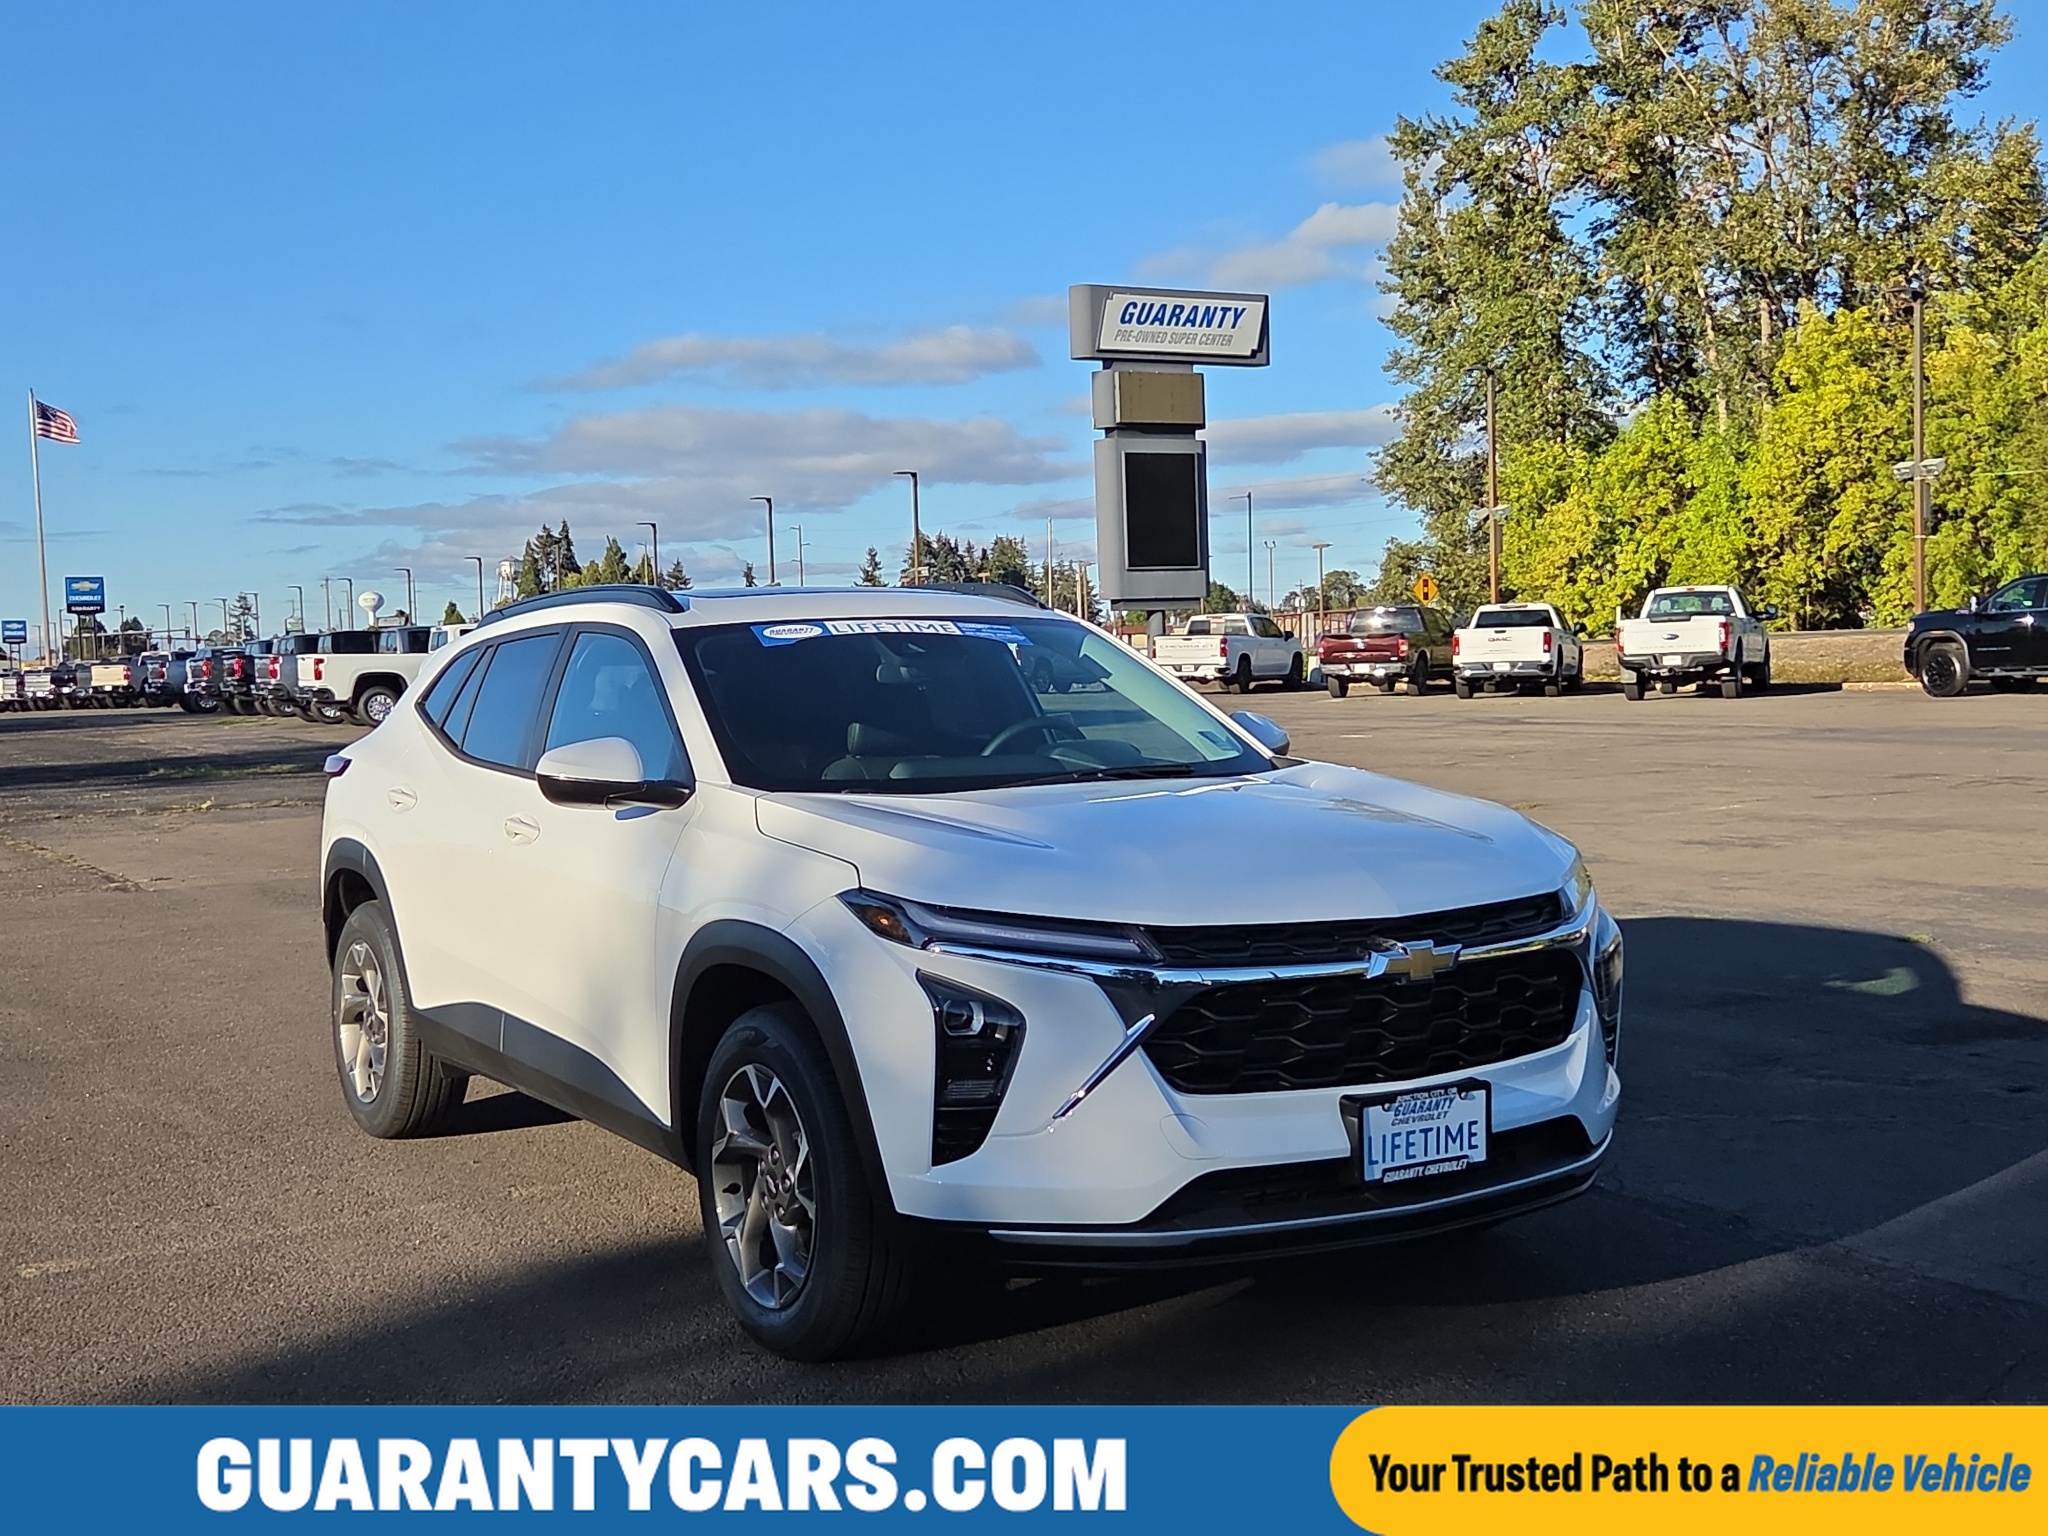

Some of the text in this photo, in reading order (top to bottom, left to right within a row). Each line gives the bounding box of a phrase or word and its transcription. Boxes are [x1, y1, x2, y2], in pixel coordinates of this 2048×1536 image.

[1120, 301, 1248, 329] GUARANTY
[1114, 329, 1234, 347] PRE-OWNED SUPER CENTER
[830, 622, 958, 634] LIFETIME
[1393, 1096, 1456, 1117] GUARANTY
[1391, 1111, 1450, 1126] CHEVROLET
[1367, 1120, 1479, 1165] LIFETIME
